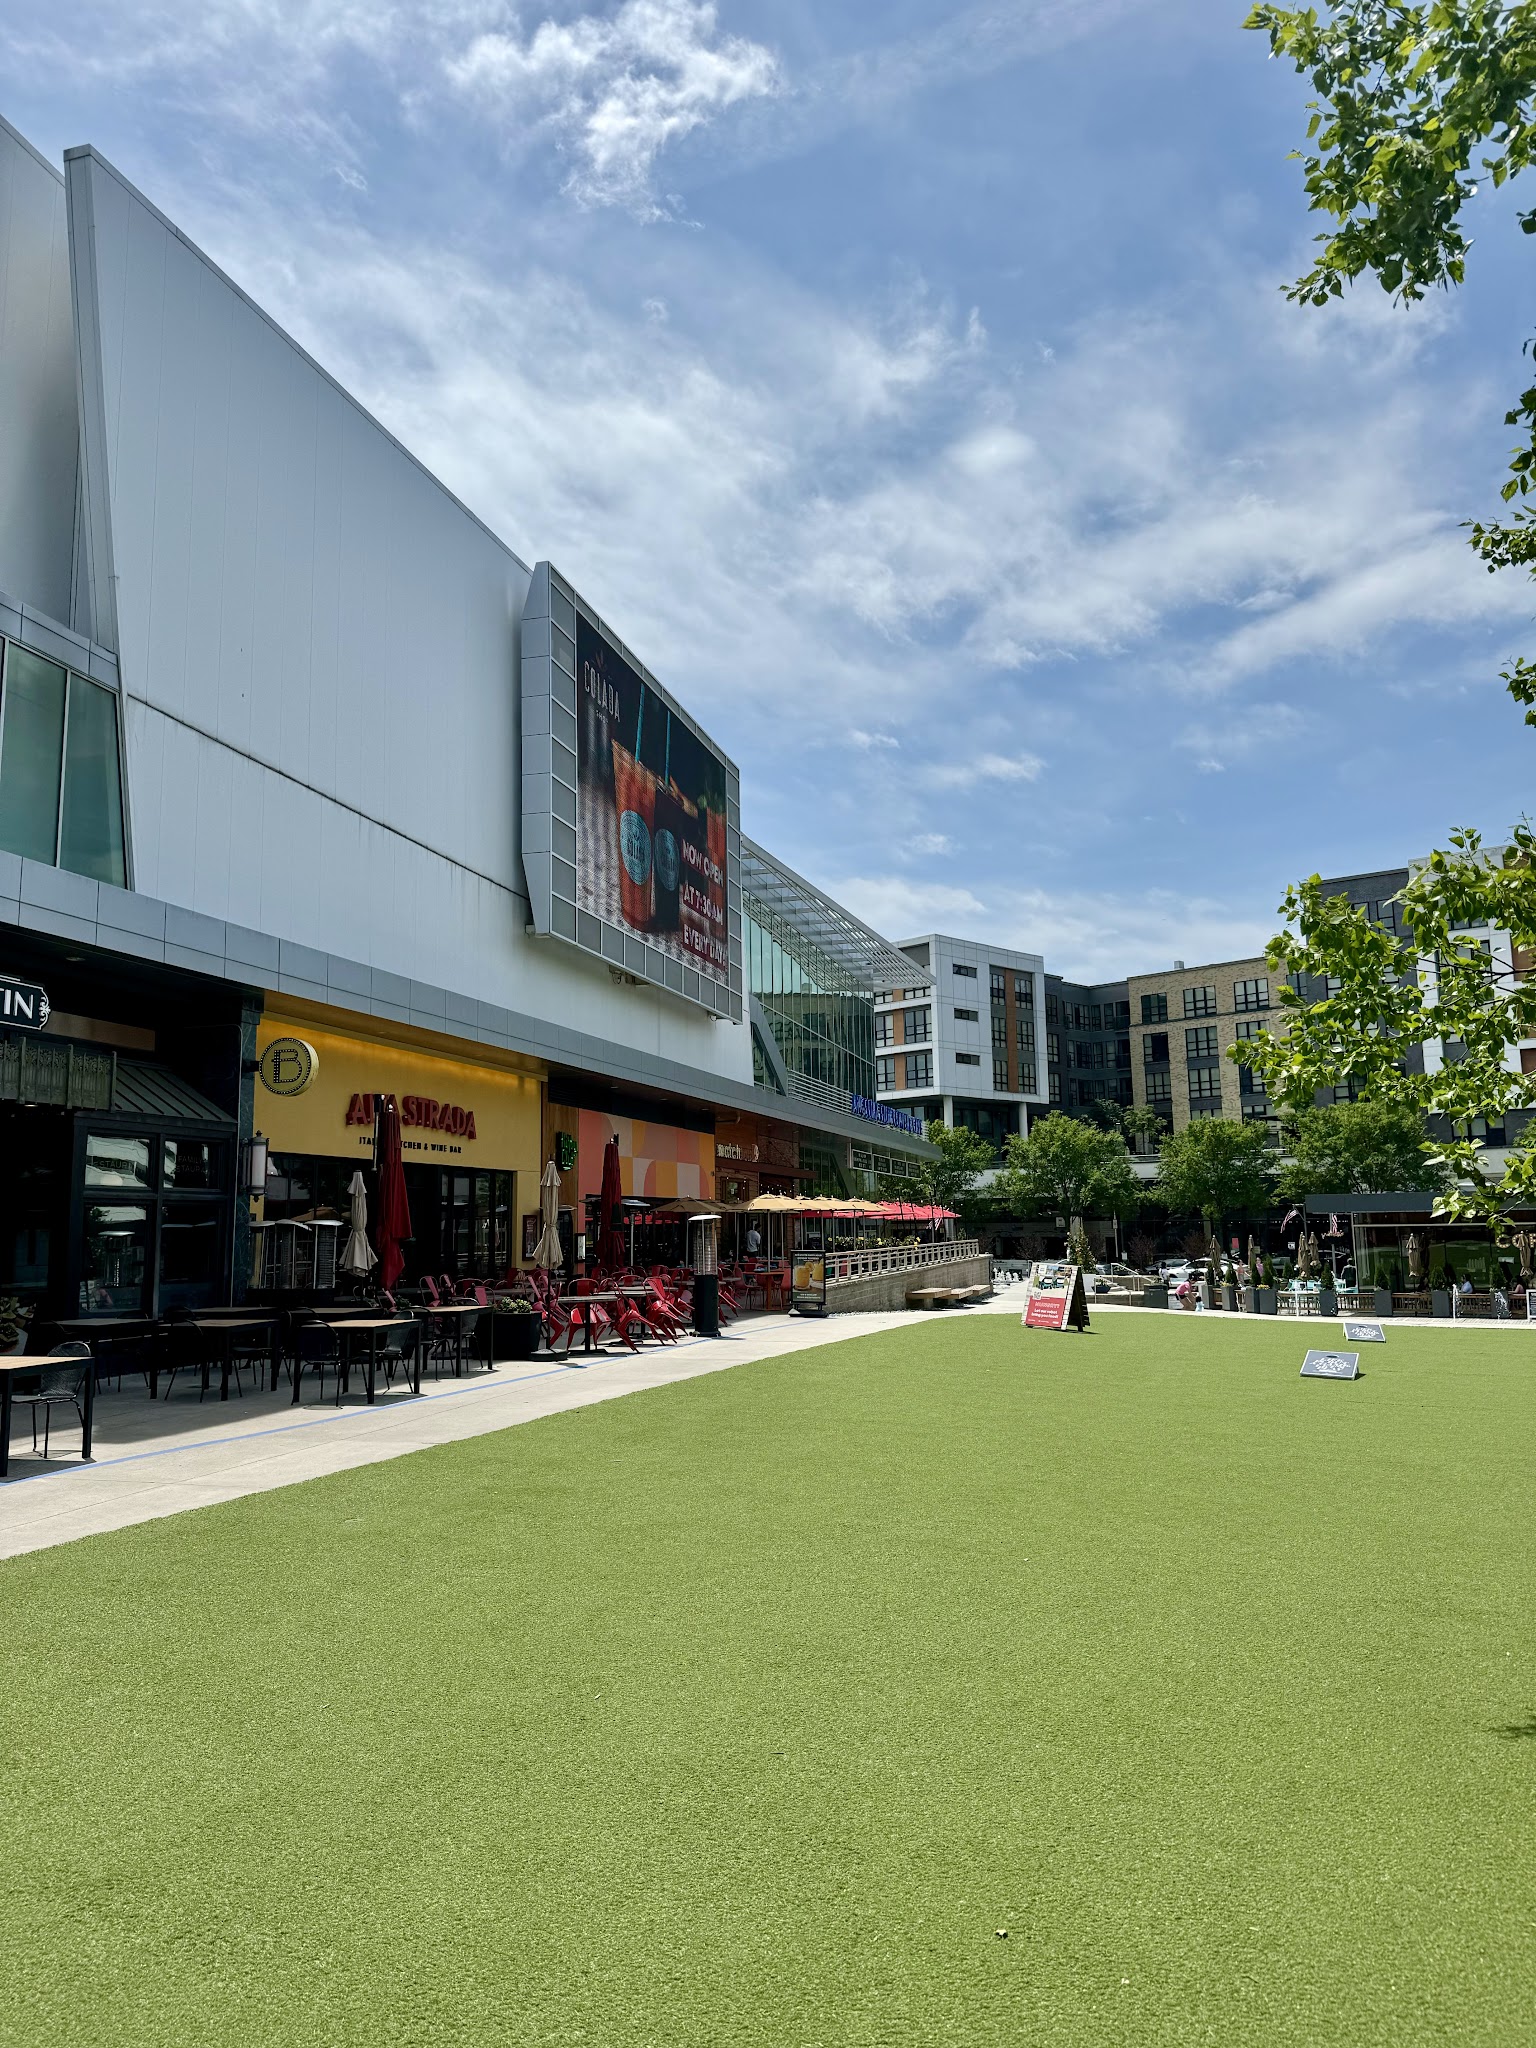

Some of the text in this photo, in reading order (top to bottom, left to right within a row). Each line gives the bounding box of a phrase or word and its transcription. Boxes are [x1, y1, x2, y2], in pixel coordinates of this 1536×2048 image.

[584, 660, 620, 722] COLADA
[682, 838, 702, 870] NOW
[703, 856, 724, 888] OPEN
[683, 881, 694, 905] AT
[683, 923, 708, 956] EVERY
[401, 1095, 477, 1140] STRADA
[431, 1143, 447, 1153] WINE
[450, 1145, 462, 1154] BAR
